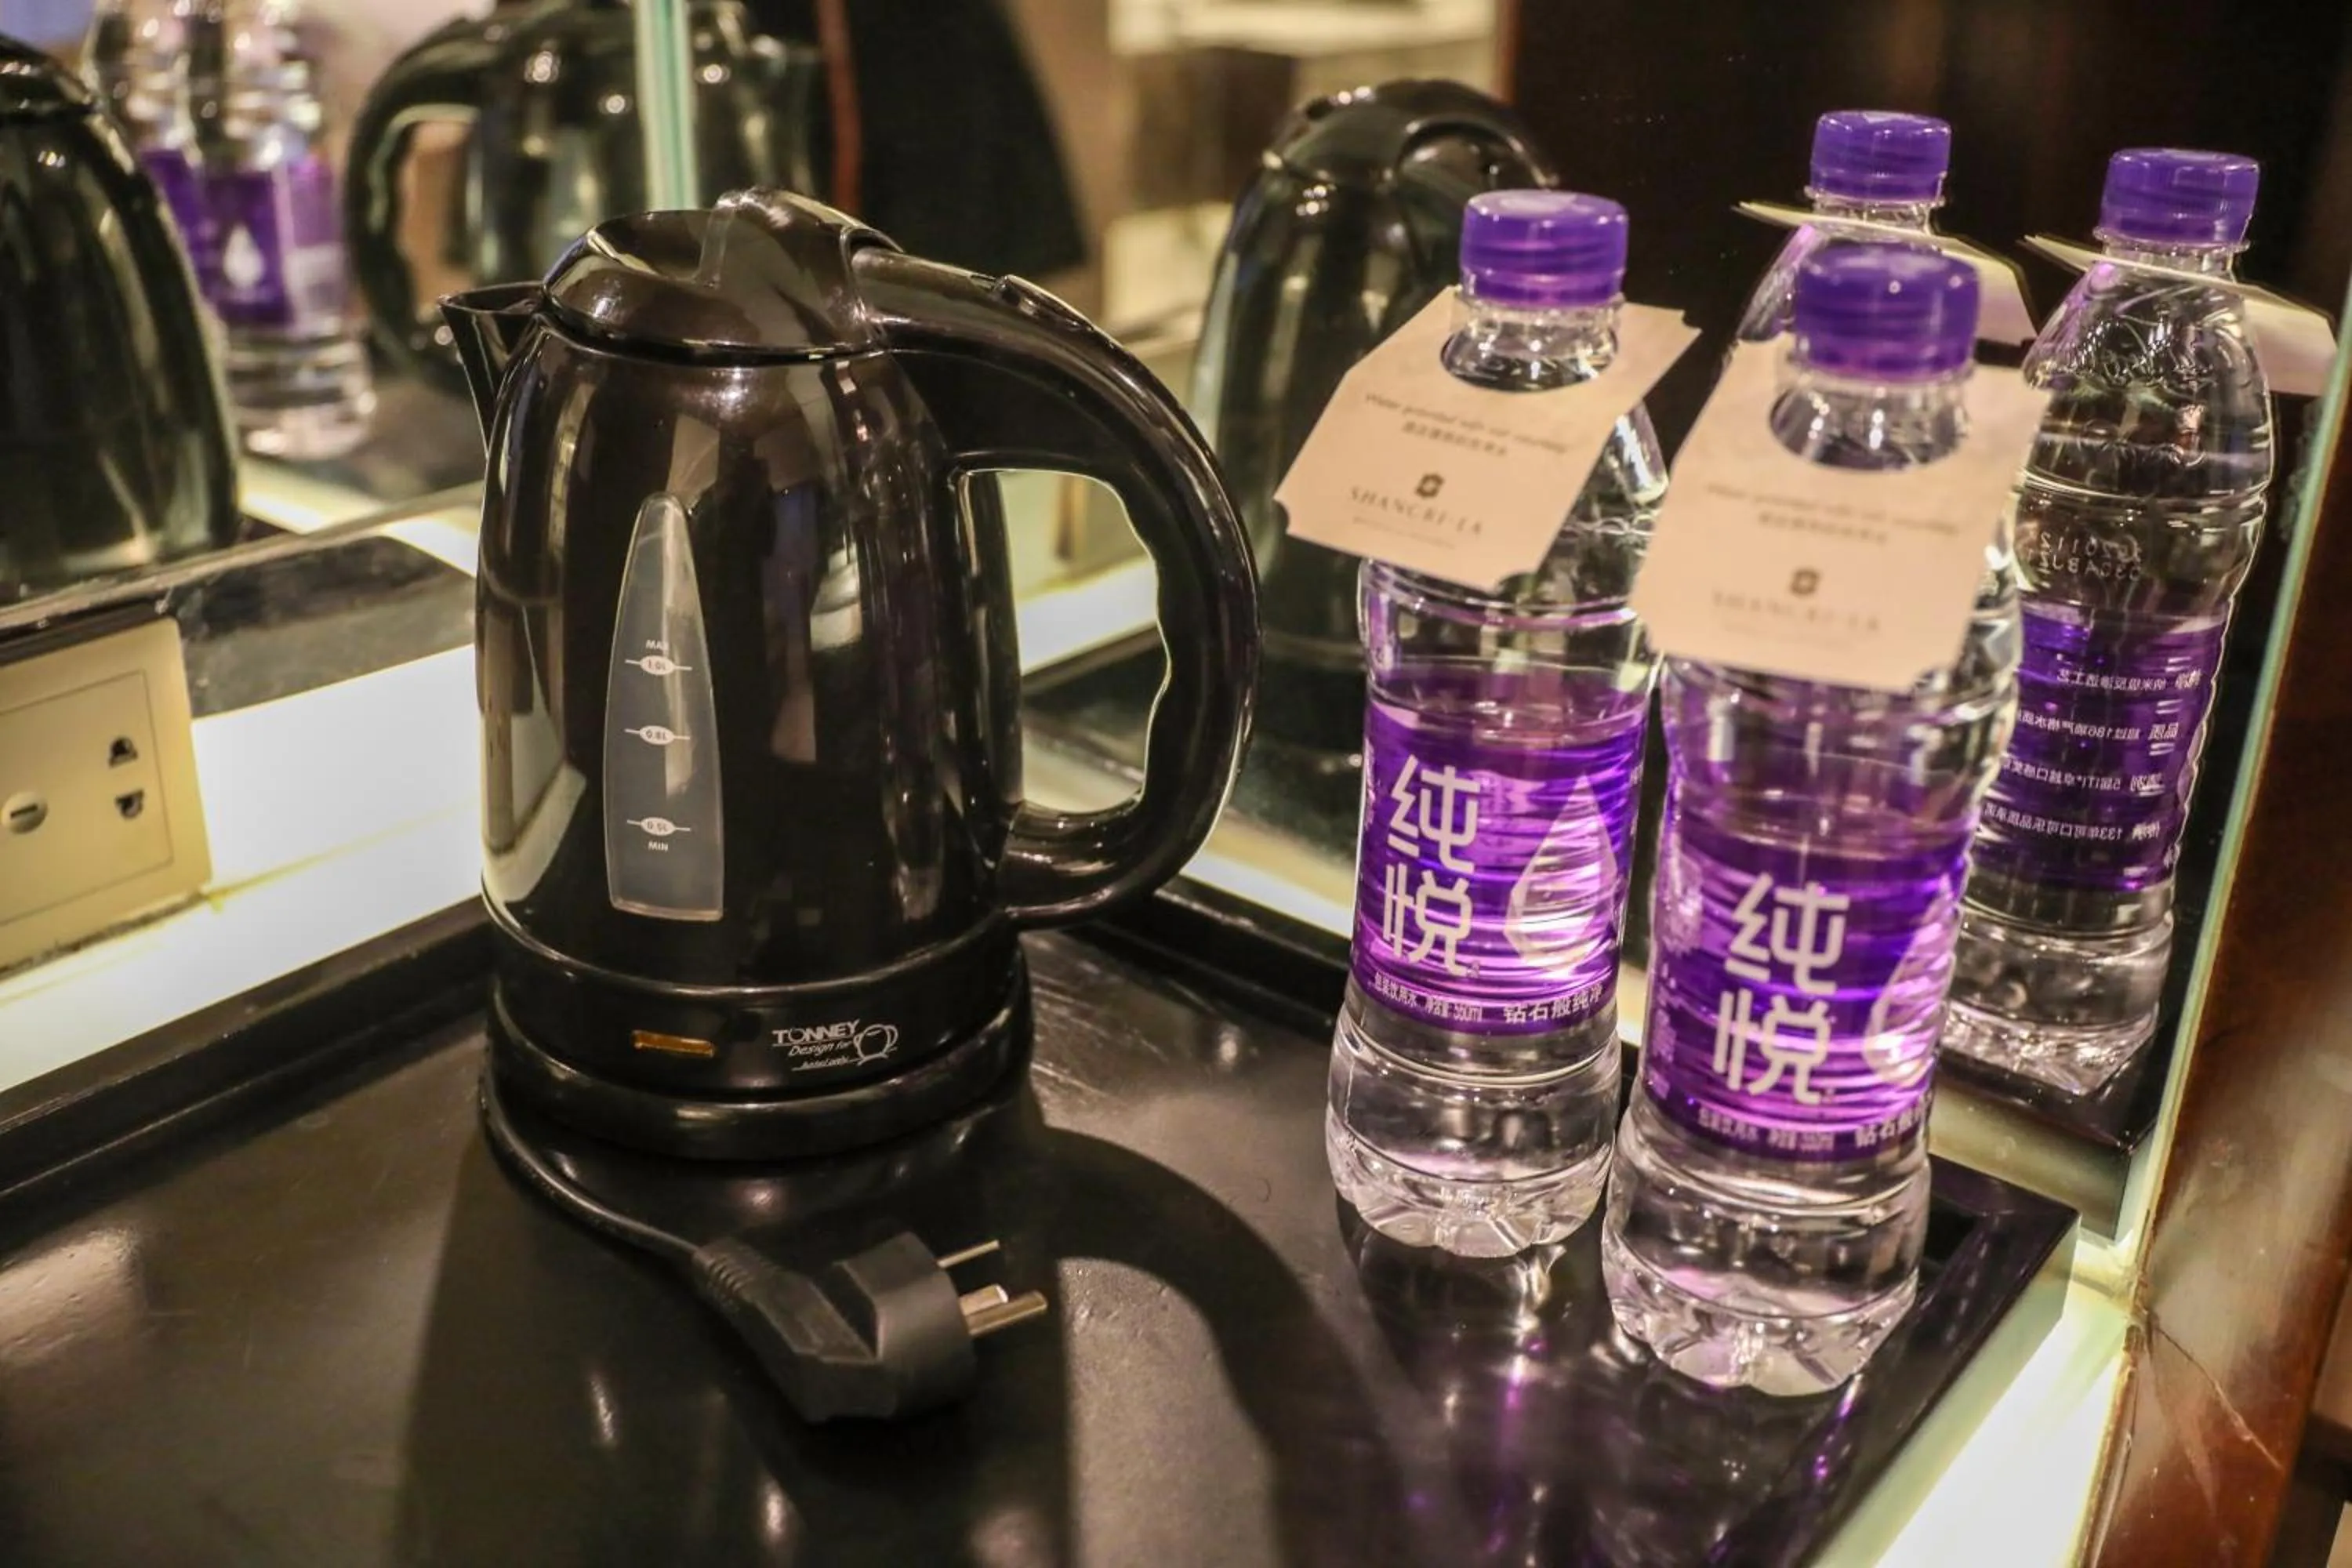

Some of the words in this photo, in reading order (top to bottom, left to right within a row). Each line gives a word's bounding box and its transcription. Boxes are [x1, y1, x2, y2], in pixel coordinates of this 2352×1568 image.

[1382, 753, 1481, 977] 纯悦
[772, 1018, 861, 1044] TONNEY
[1711, 871, 1850, 1105] 纯悦
